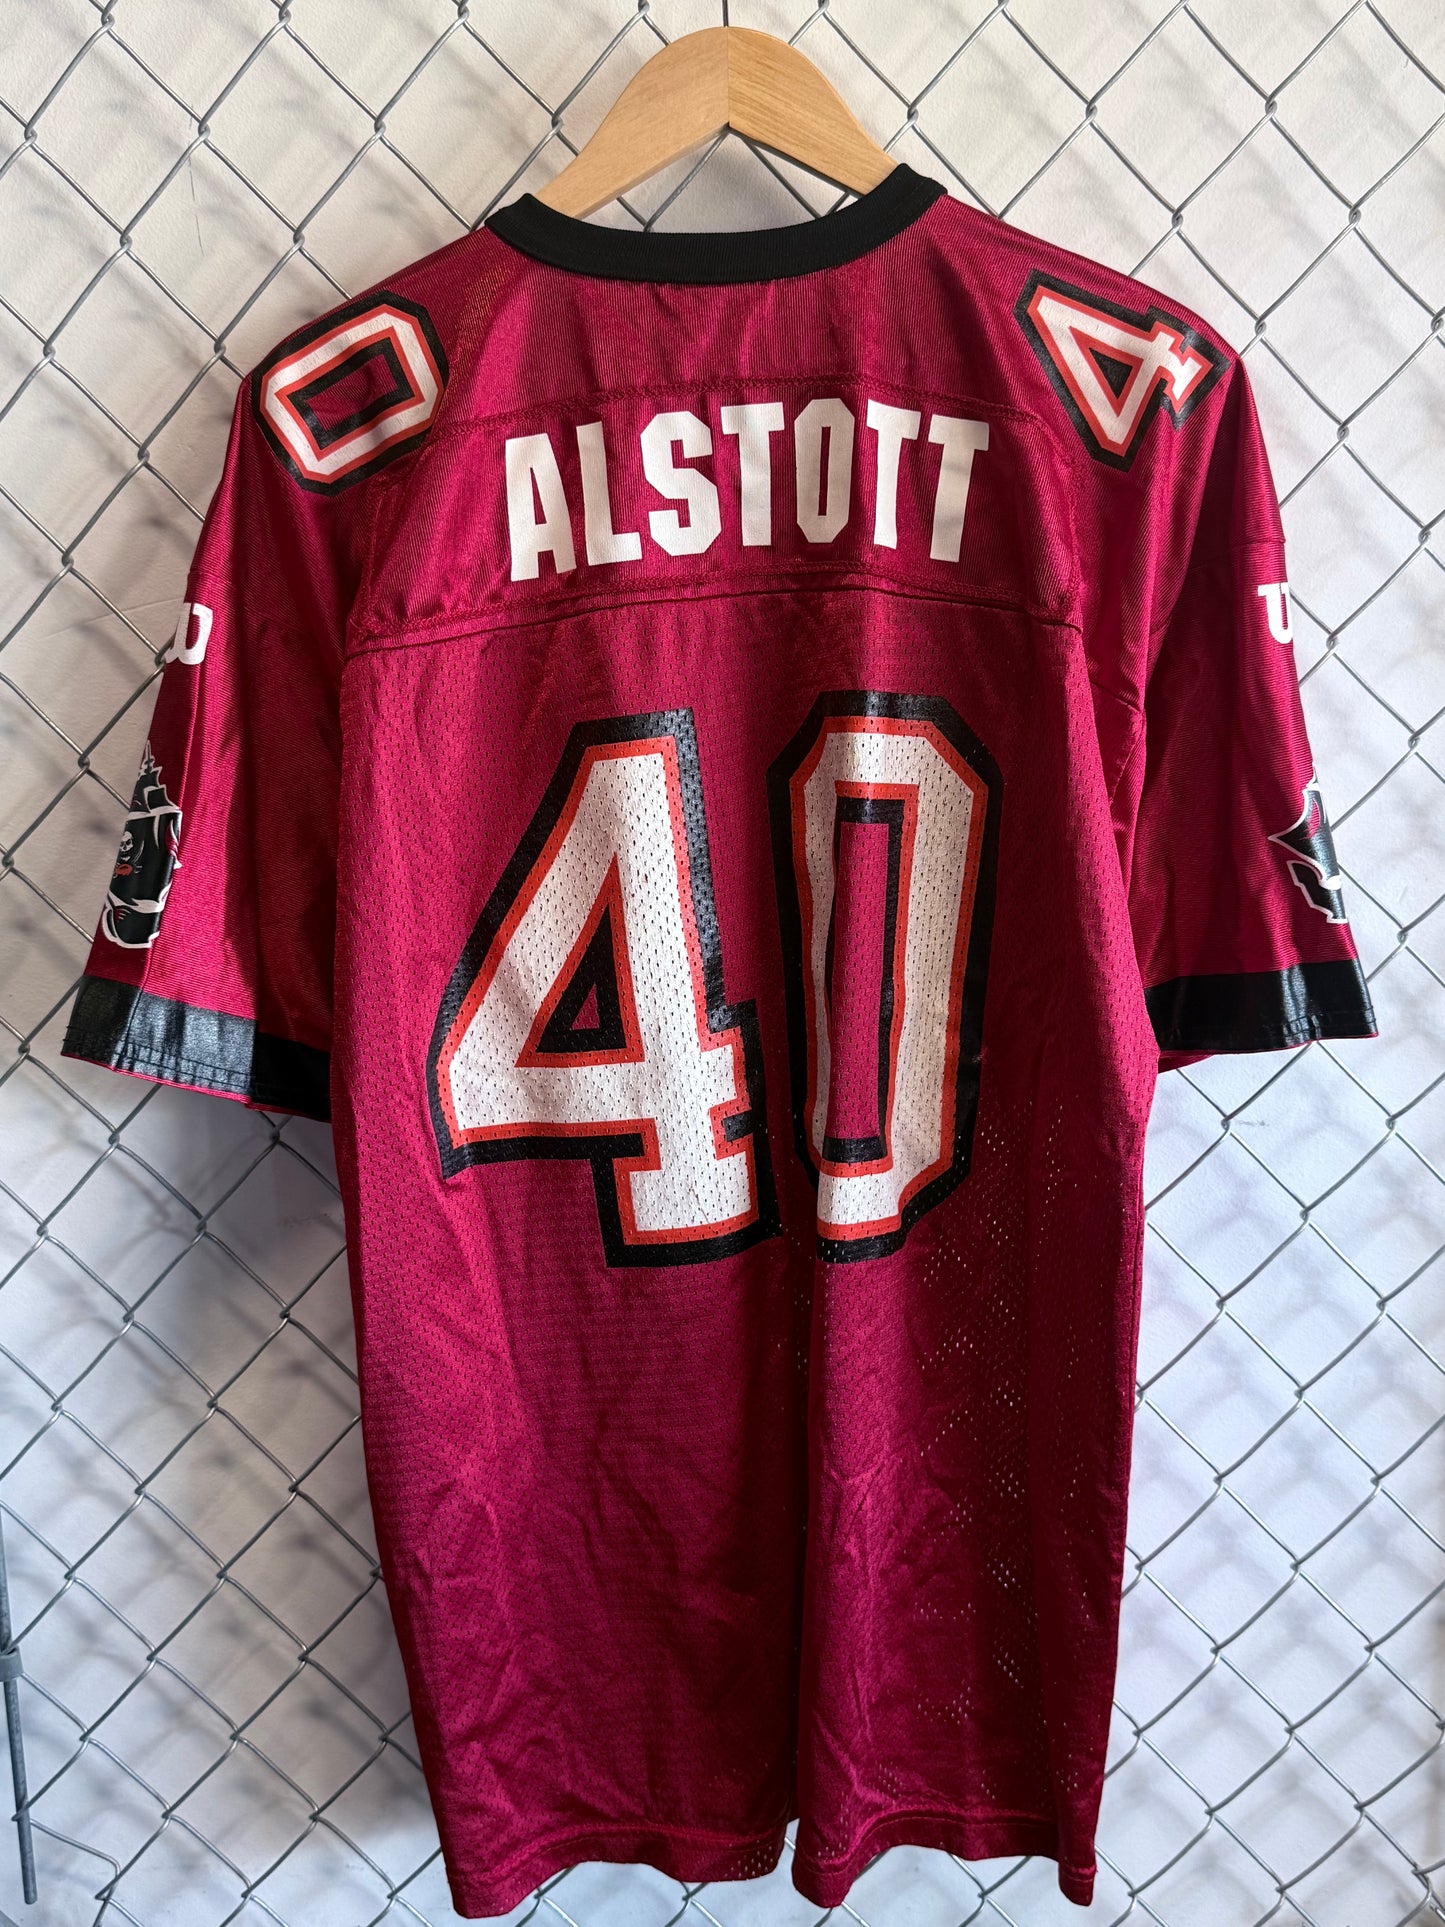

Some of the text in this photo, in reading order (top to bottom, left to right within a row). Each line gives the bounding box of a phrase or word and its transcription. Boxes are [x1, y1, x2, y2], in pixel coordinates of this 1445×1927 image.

[1013, 269, 1230, 472] 4
[505, 398, 989, 582] ALSTOTT
[426, 690, 1004, 1268] 40
